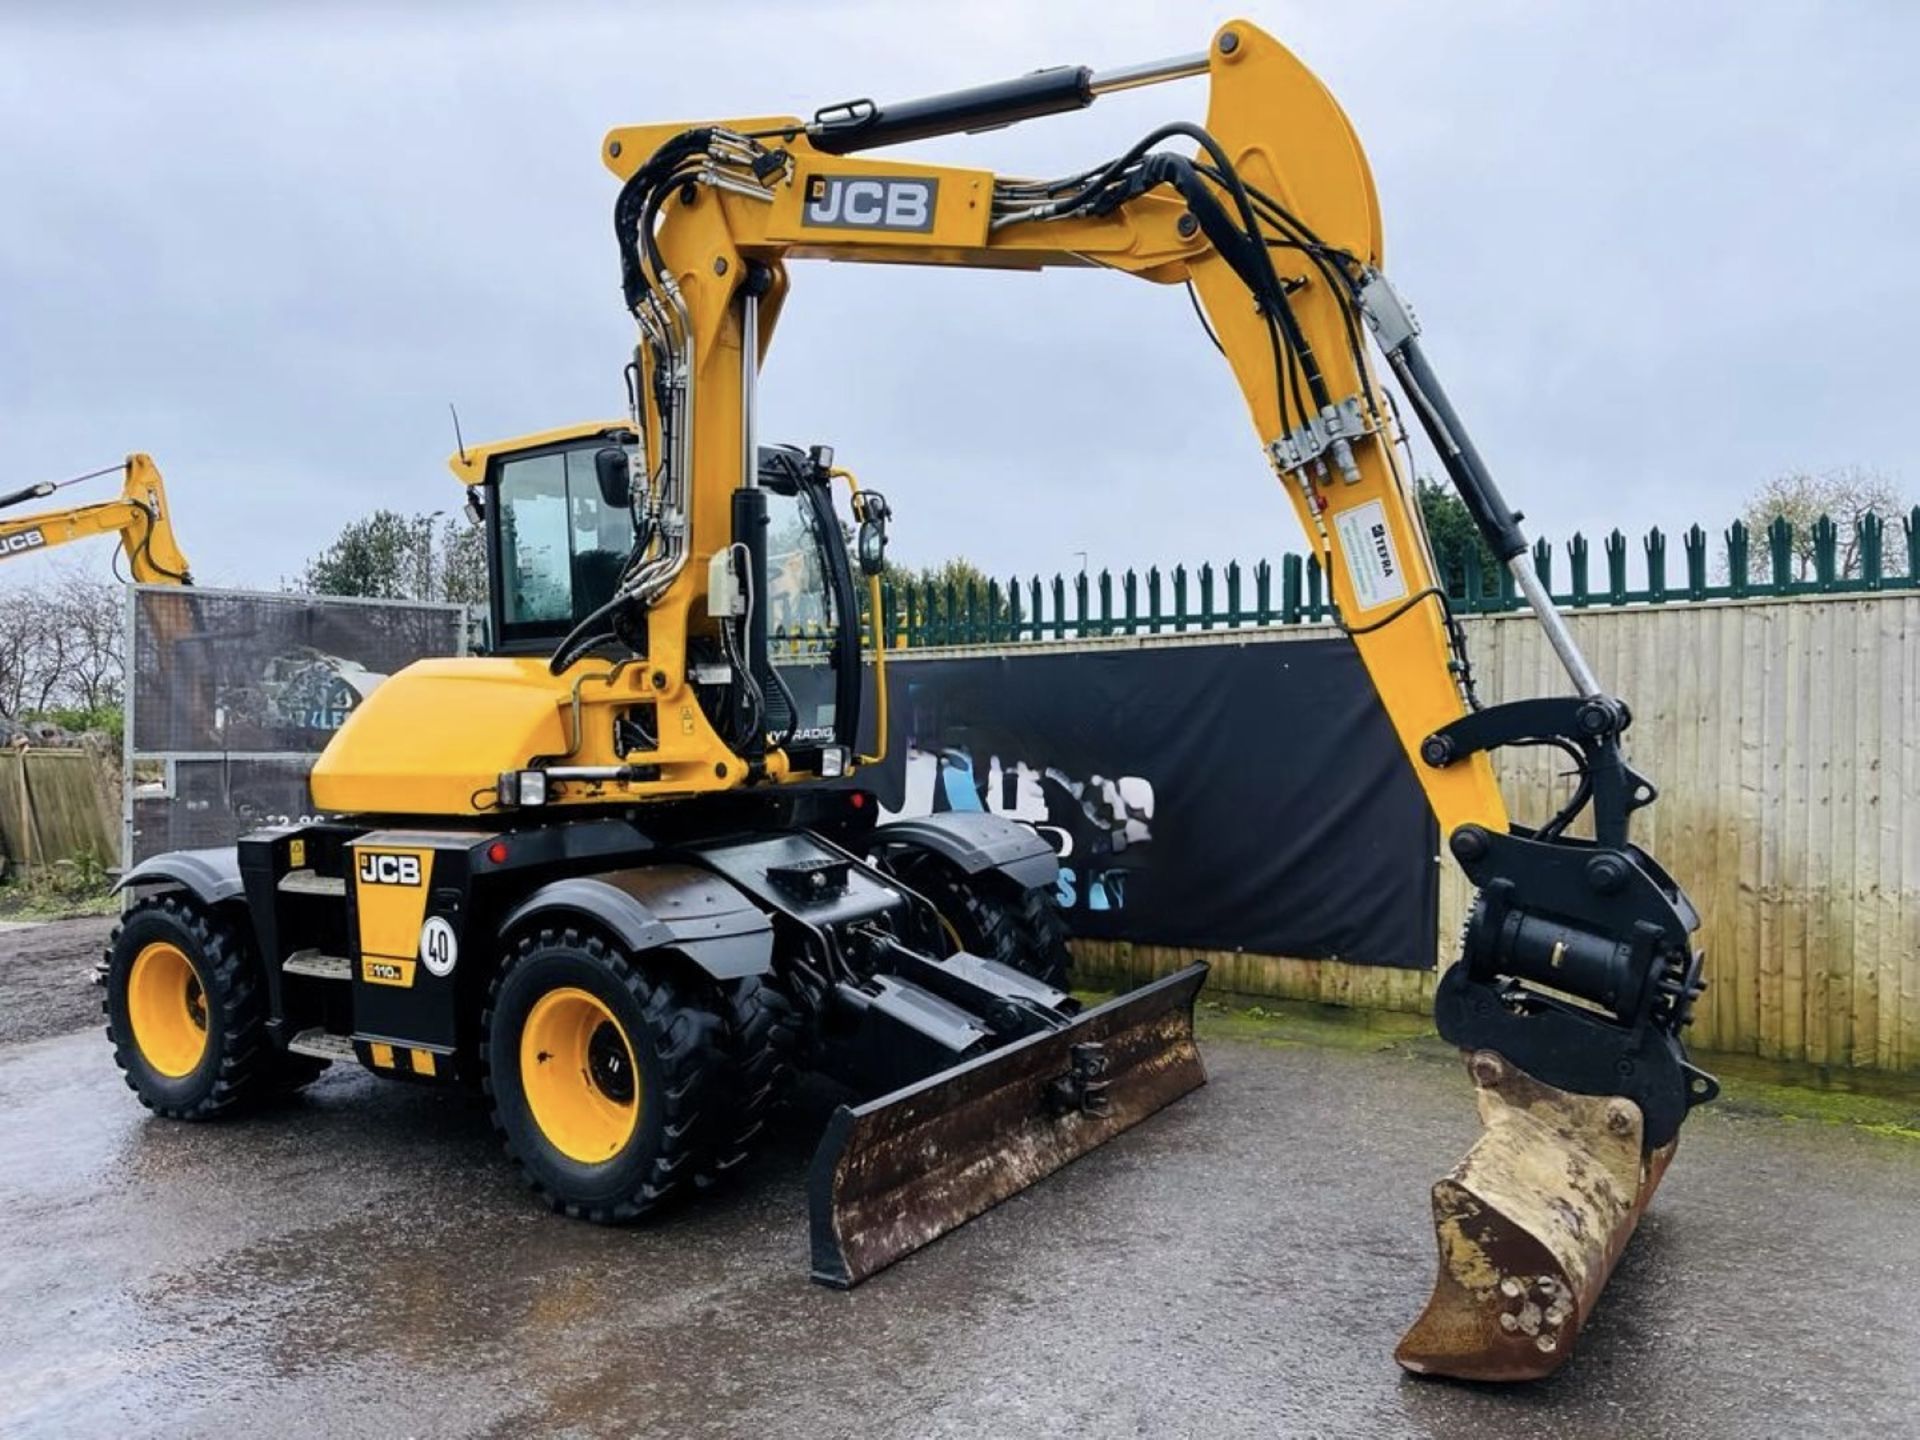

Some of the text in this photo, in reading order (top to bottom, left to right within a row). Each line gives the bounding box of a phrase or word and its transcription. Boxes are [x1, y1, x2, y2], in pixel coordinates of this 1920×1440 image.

[810, 181, 929, 227] JCB
[361, 855, 420, 884] JCB
[429, 929, 448, 963] 40
